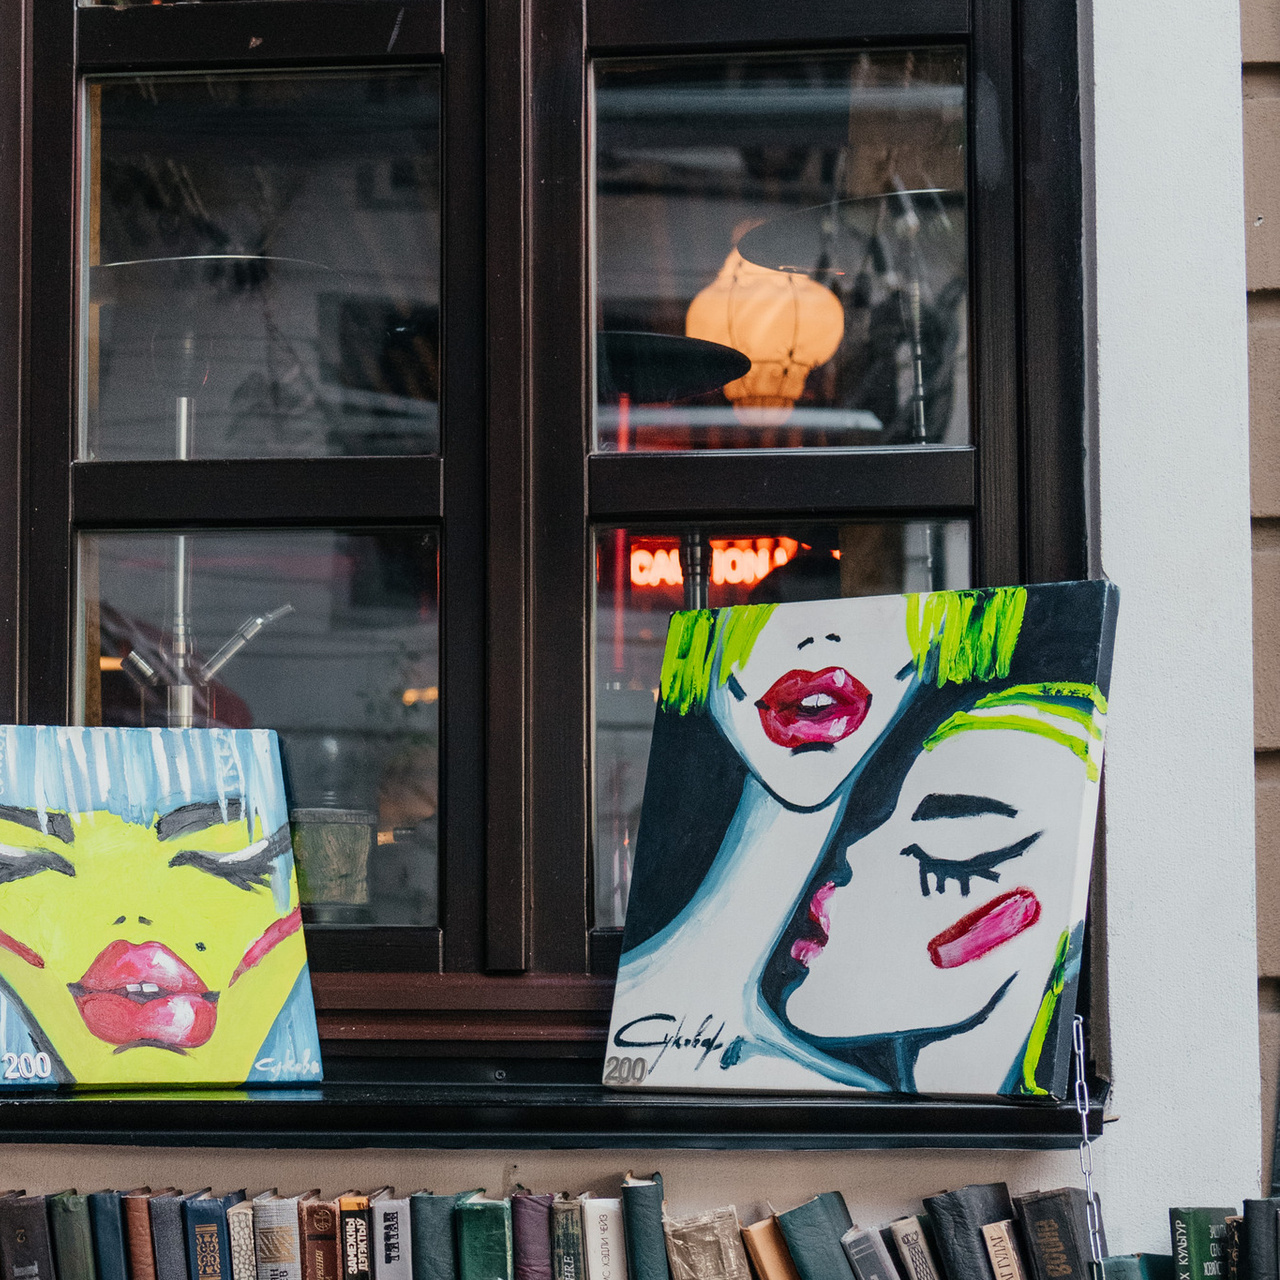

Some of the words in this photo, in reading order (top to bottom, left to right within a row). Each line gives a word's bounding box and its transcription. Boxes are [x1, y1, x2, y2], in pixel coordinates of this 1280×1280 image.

[1, 1051, 51, 1079] 200
[604, 1056, 648, 1083] 200
[598, 1214, 608, 1236] ЧЕЙЗ
[346, 1217, 358, 1275] ЗАМЕЖНЫ
[600, 1237, 610, 1267] ХЭДЛИ
[990, 1235, 1011, 1269] ГУЛАГ
[1175, 1219, 1189, 1266] КУЛЬТУР
